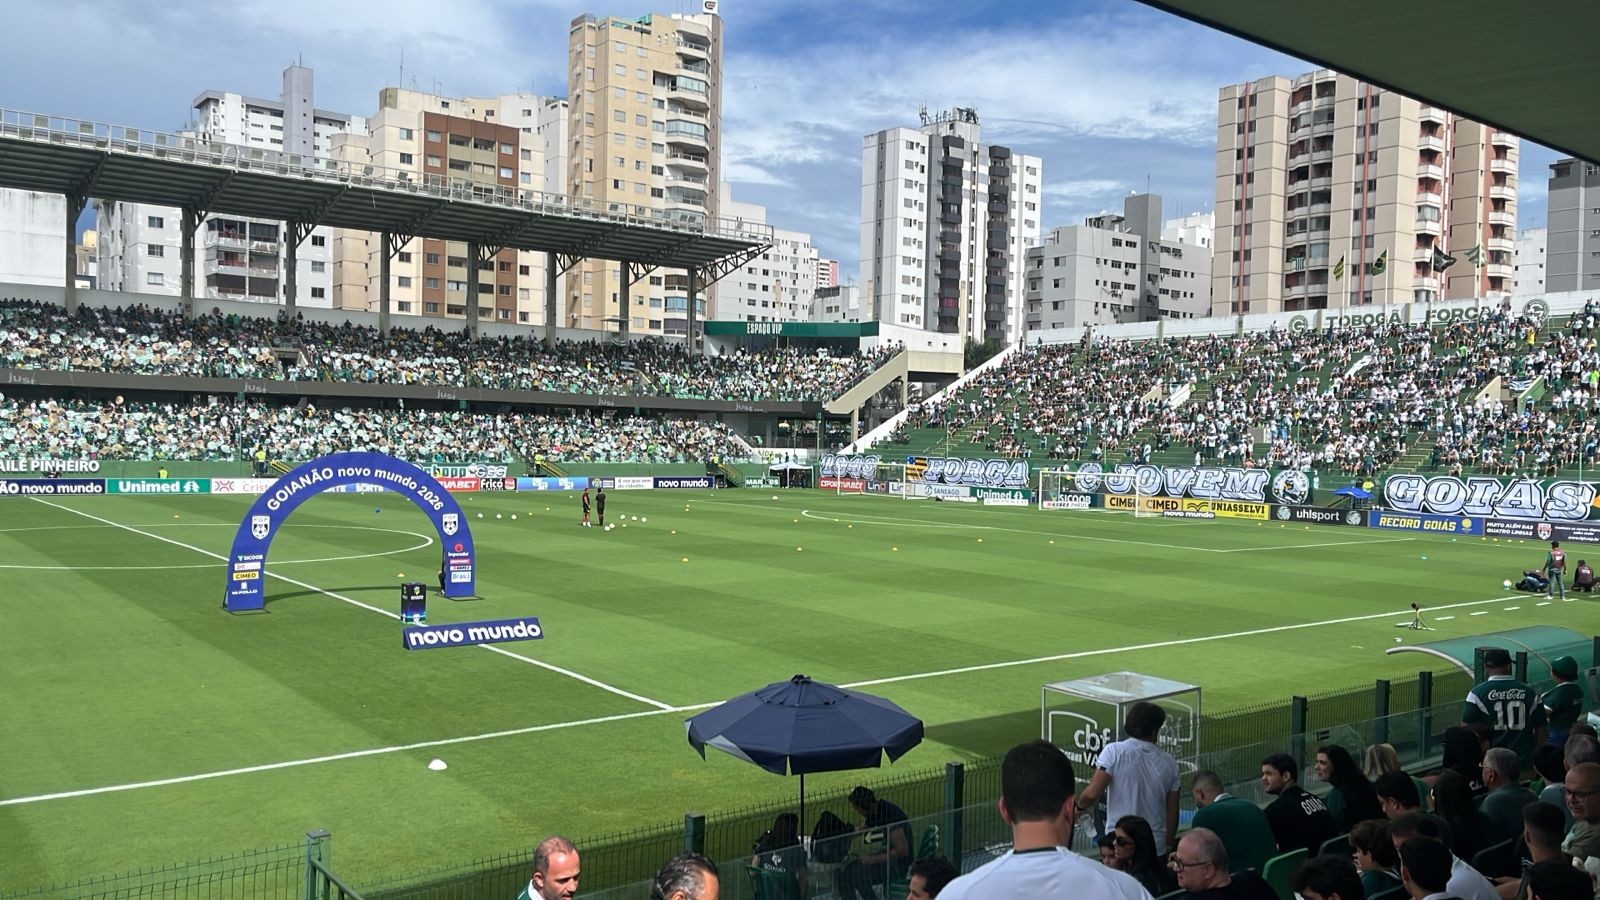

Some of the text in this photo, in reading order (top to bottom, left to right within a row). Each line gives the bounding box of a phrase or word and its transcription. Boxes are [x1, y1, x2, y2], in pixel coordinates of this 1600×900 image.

[747, 323, 783, 336] ESPAÇO VIP
[30, 459, 100, 472] PINHEIRO
[923, 456, 1029, 487] FORÇA
[22, 485, 54, 494] novo
[57, 482, 102, 494] mundo
[119, 481, 180, 492] Unimed
[267, 467, 444, 511] GOIANÃO novo mundo 2026
[680, 478, 708, 487] mundo
[1105, 464, 1270, 503] JOVEM
[933, 487, 960, 495] SANEAGO
[976, 489, 1012, 499] Unimed
[1059, 494, 1091, 505] SICOOB
[1211, 502, 1265, 514] UNIASSELVI
[1296, 504, 1340, 521] uhlsport
[1379, 516, 1457, 531] RECORD GOIÁS
[409, 620, 541, 646] novo mundo
[1494, 700, 1526, 731] 10
[1074, 723, 1111, 751] cbf
